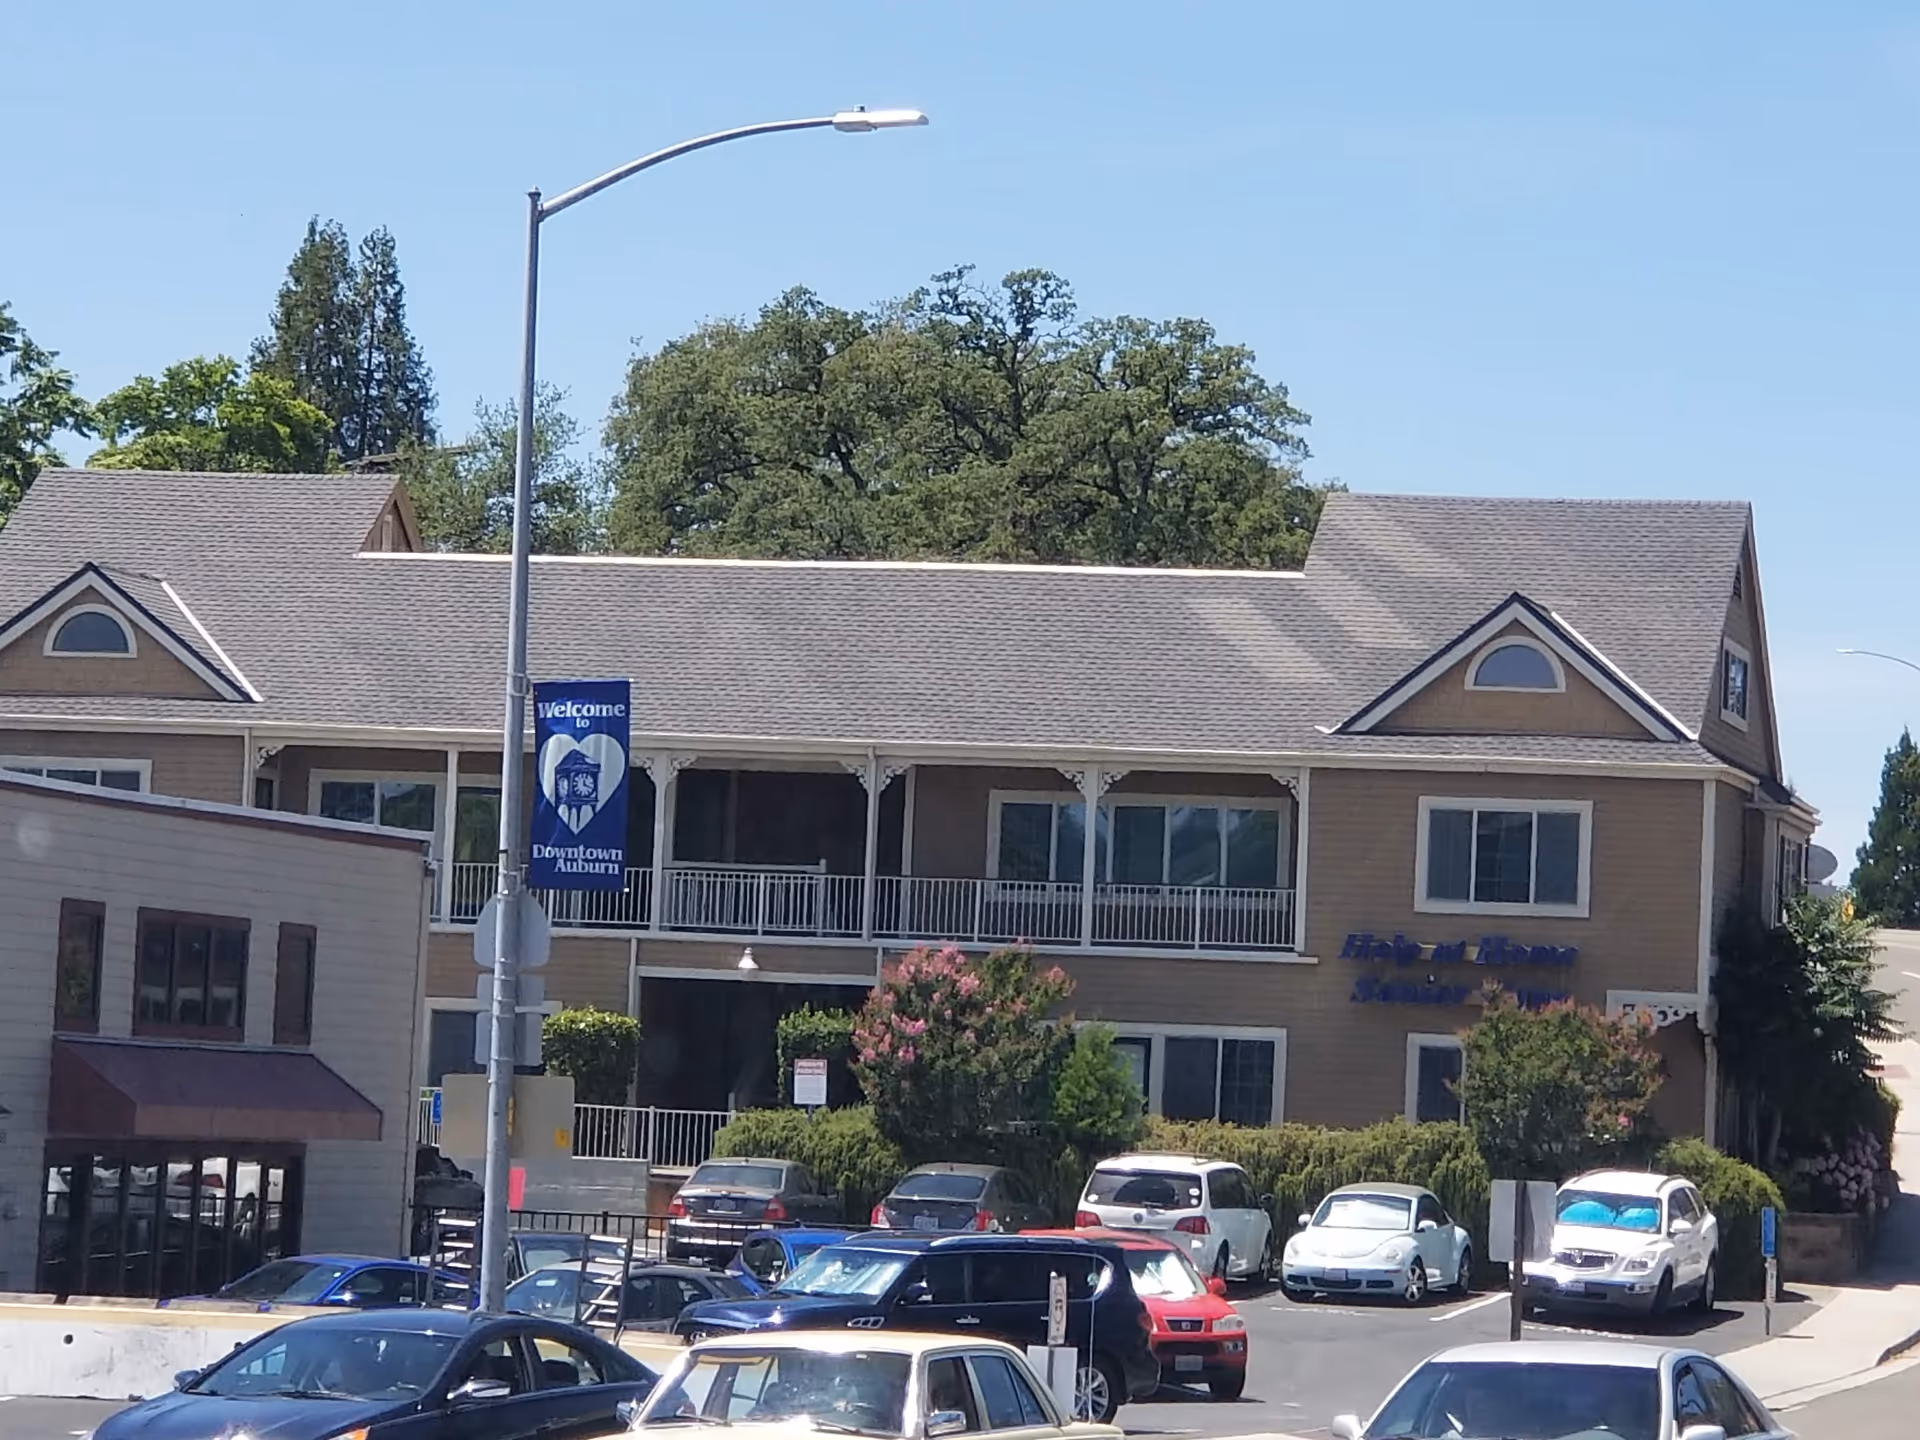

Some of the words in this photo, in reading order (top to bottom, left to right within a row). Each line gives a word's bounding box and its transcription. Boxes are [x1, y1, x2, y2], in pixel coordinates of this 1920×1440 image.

[537, 701, 625, 718] Welcome
[576, 718, 590, 728] to
[532, 844, 623, 861] Downtown
[554, 858, 619, 875] Auburn
